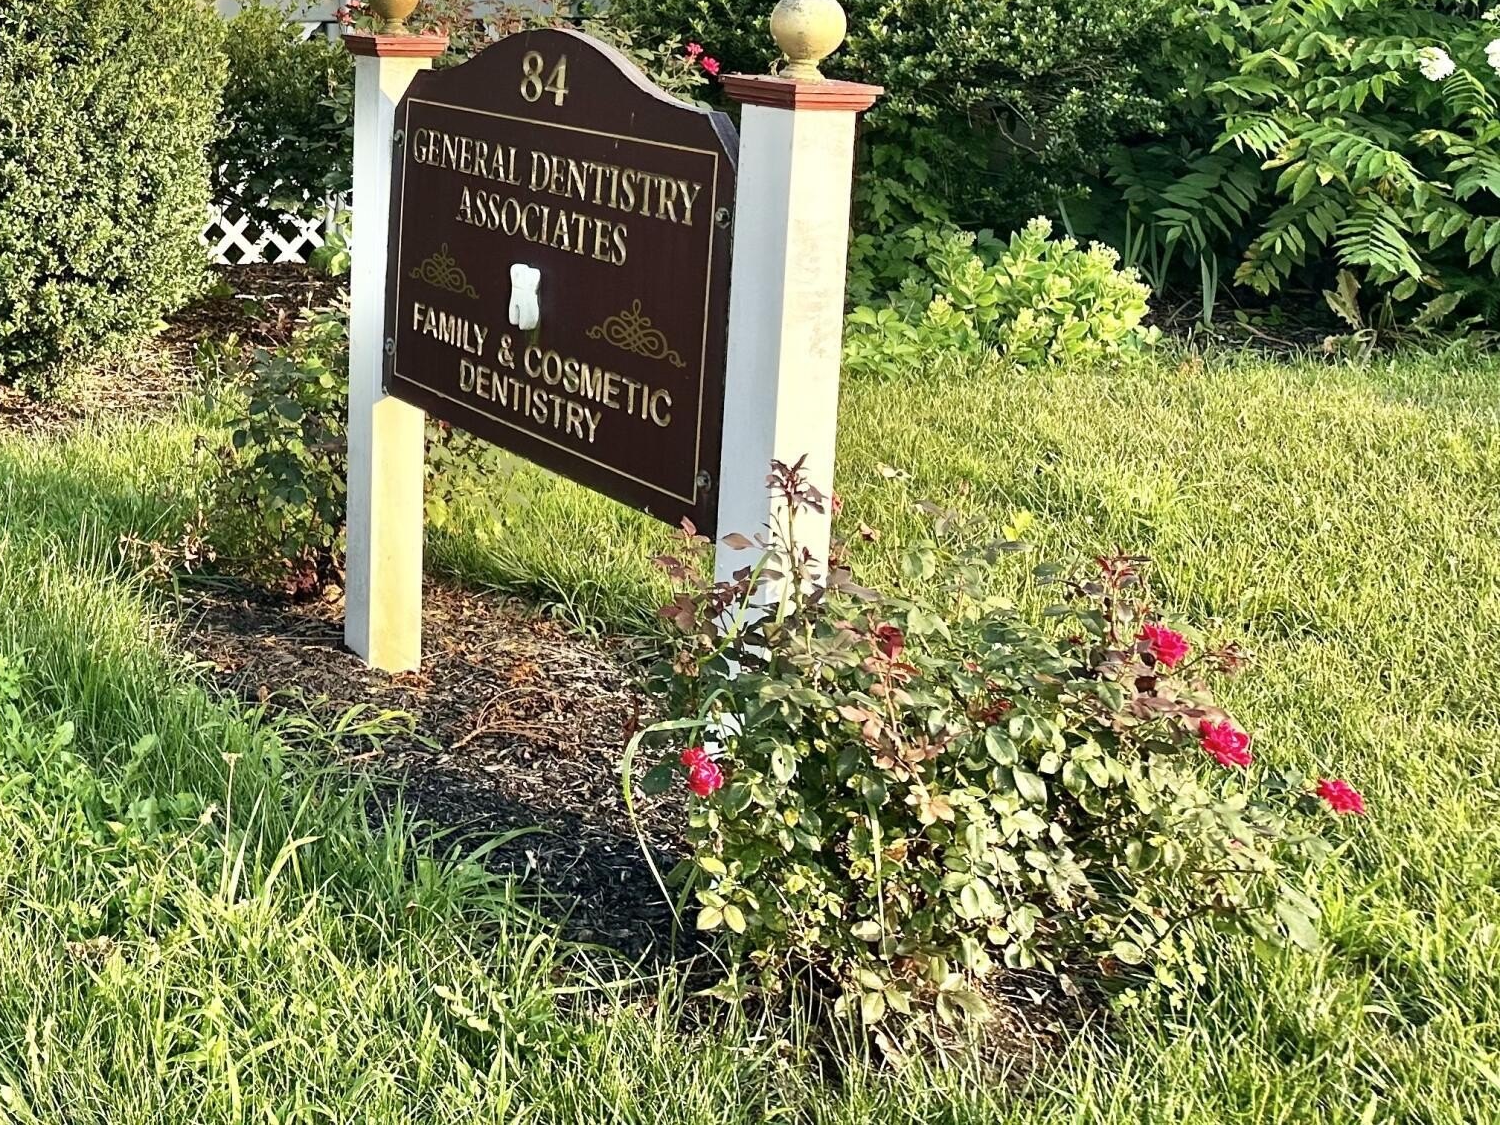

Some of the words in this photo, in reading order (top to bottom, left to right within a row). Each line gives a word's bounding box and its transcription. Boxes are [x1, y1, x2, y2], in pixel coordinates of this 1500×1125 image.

[520, 50, 569, 107] 84
[413, 128, 520, 186] GENERAL
[530, 150, 702, 226] DENTISTRY
[456, 186, 628, 266] ASSOCIATES
[413, 302, 489, 356] FAMILY
[497, 336, 516, 368] &
[524, 346, 673, 428] COSMETIC
[460, 359, 602, 444] DENTISTRY
